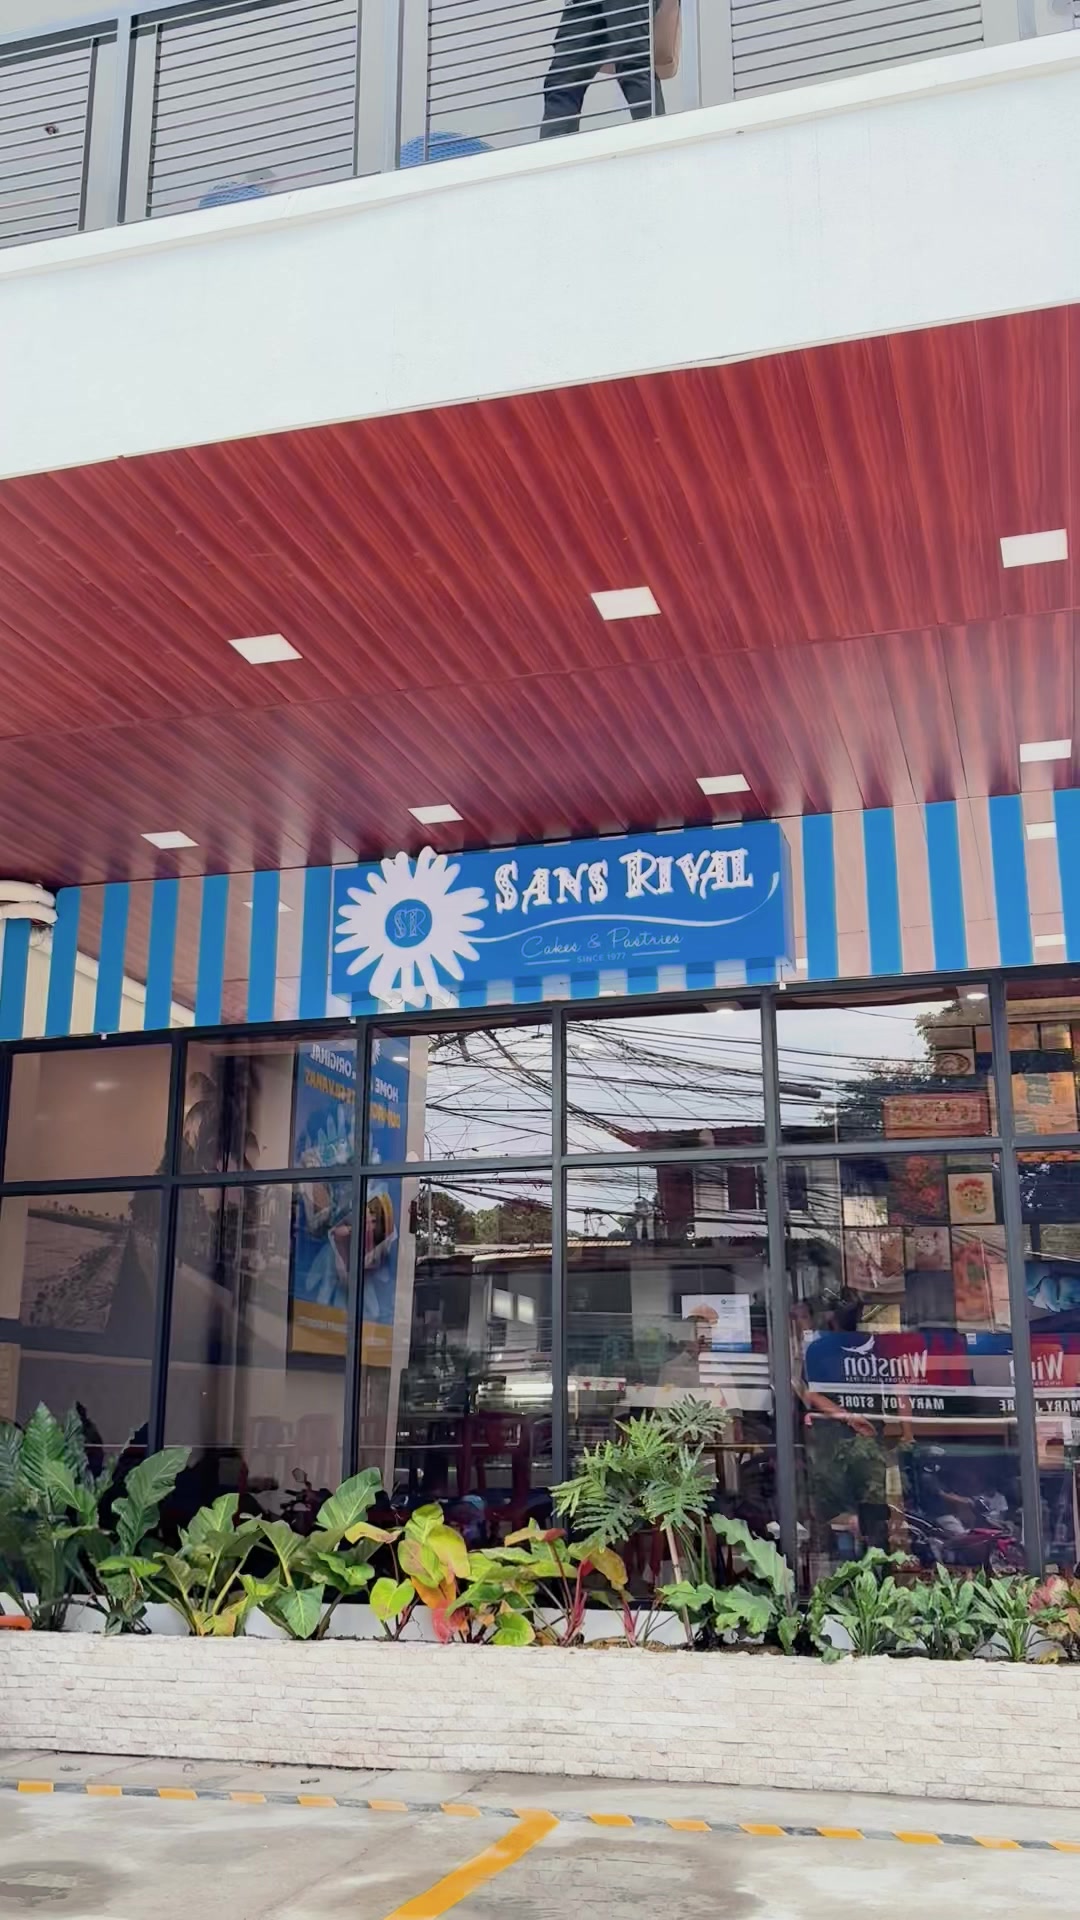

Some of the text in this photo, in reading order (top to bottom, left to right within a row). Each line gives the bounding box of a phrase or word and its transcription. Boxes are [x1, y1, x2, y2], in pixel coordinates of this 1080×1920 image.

[495, 848, 754, 914] SANS RIVAL
[520, 926, 684, 959] Cakes & Pastries
[577, 952, 627, 964] SINCE 1977
